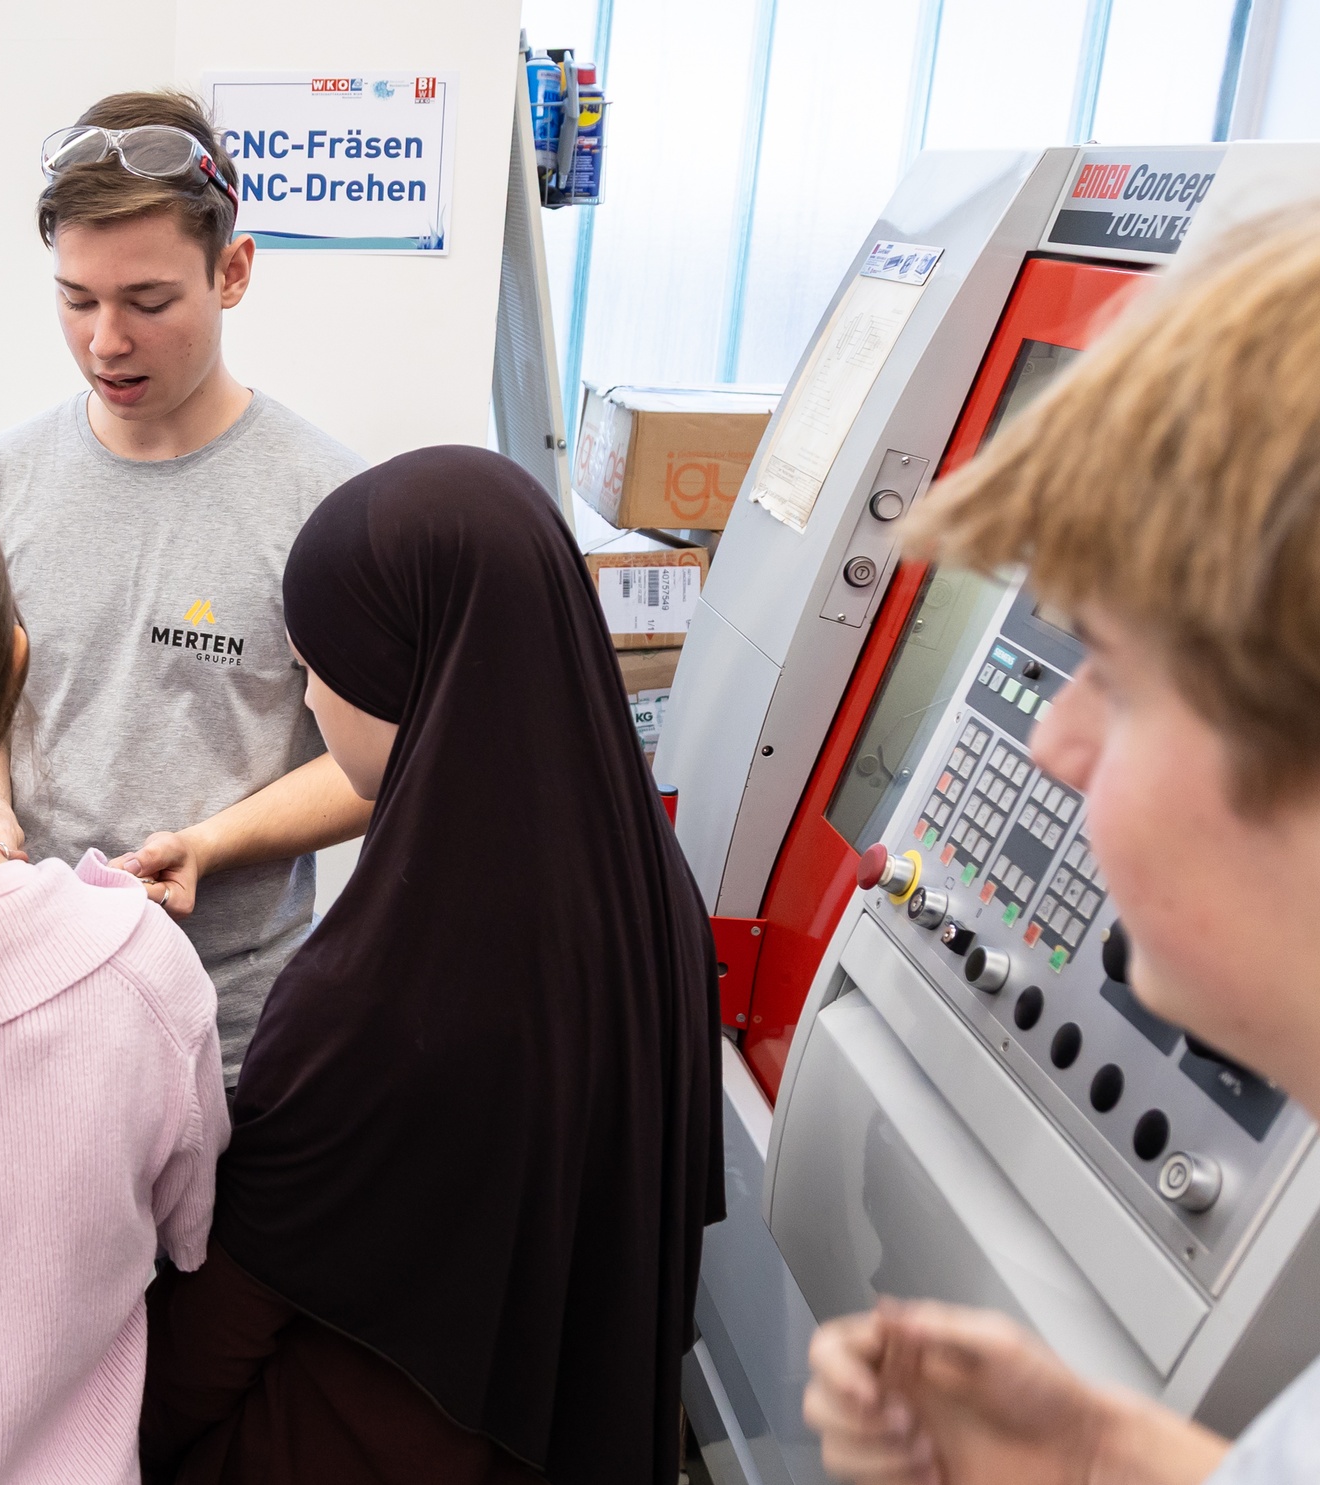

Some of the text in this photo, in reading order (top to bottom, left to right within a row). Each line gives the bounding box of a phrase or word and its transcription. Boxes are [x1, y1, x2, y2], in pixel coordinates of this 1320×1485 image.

[312, 79, 349, 91] WKO
[220, 129, 423, 159] CNC-Fräsen
[242, 173, 426, 202] NC-Drehen
[1122, 164, 1216, 212] Concep
[1106, 212, 1172, 239] TURN
[664, 452, 749, 521] igu
[661, 568, 670, 611] 40757549
[151, 626, 244, 656] MERTEN
[196, 653, 242, 666] GRUPPE
[635, 711, 654, 723] KG
